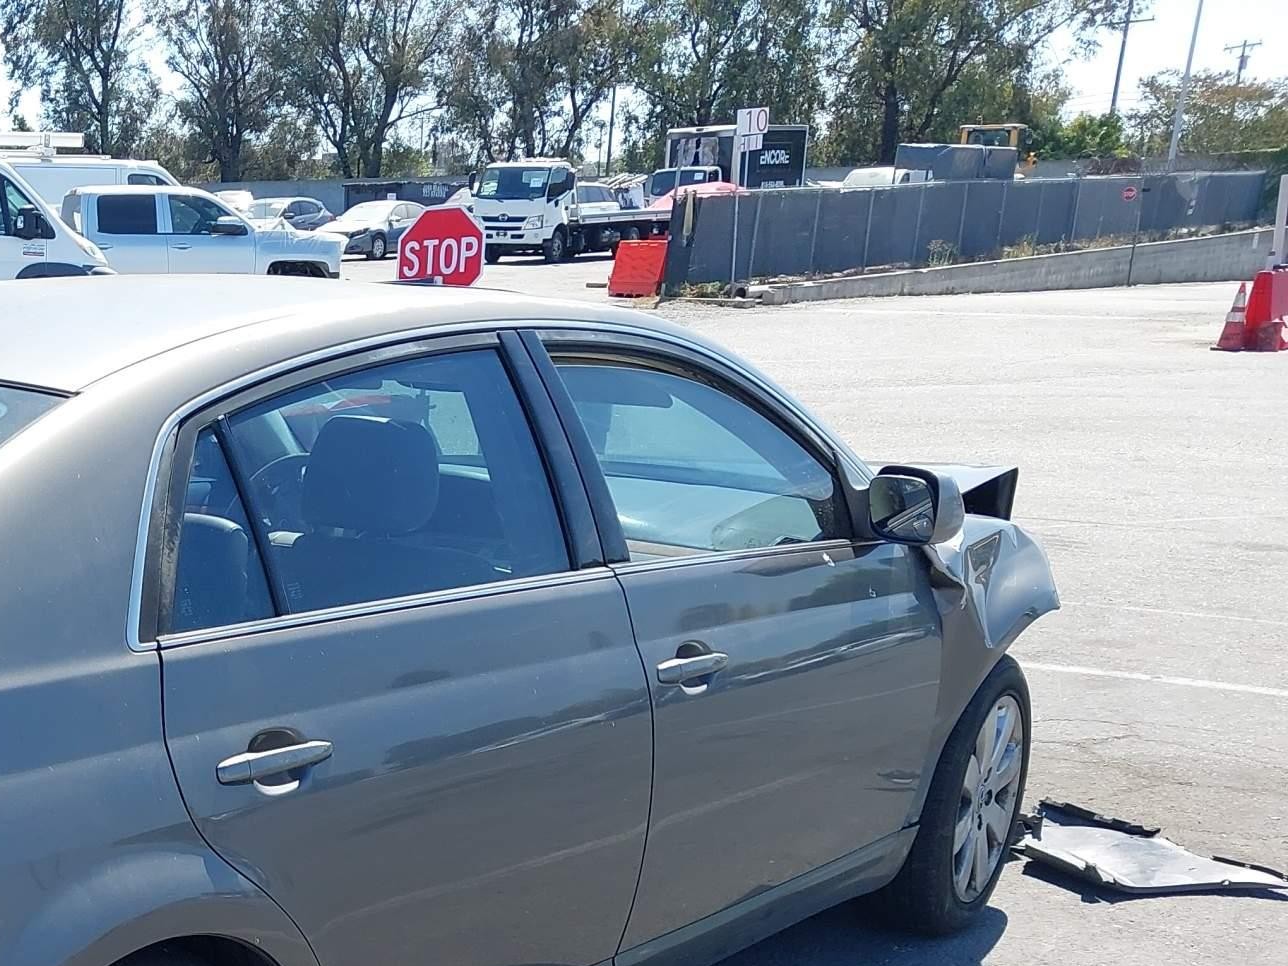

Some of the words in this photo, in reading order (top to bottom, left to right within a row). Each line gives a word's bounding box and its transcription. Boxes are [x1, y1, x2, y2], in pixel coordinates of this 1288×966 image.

[746, 109, 767, 133] 10
[760, 149, 790, 165] ENCORE
[403, 236, 479, 277] STOP
